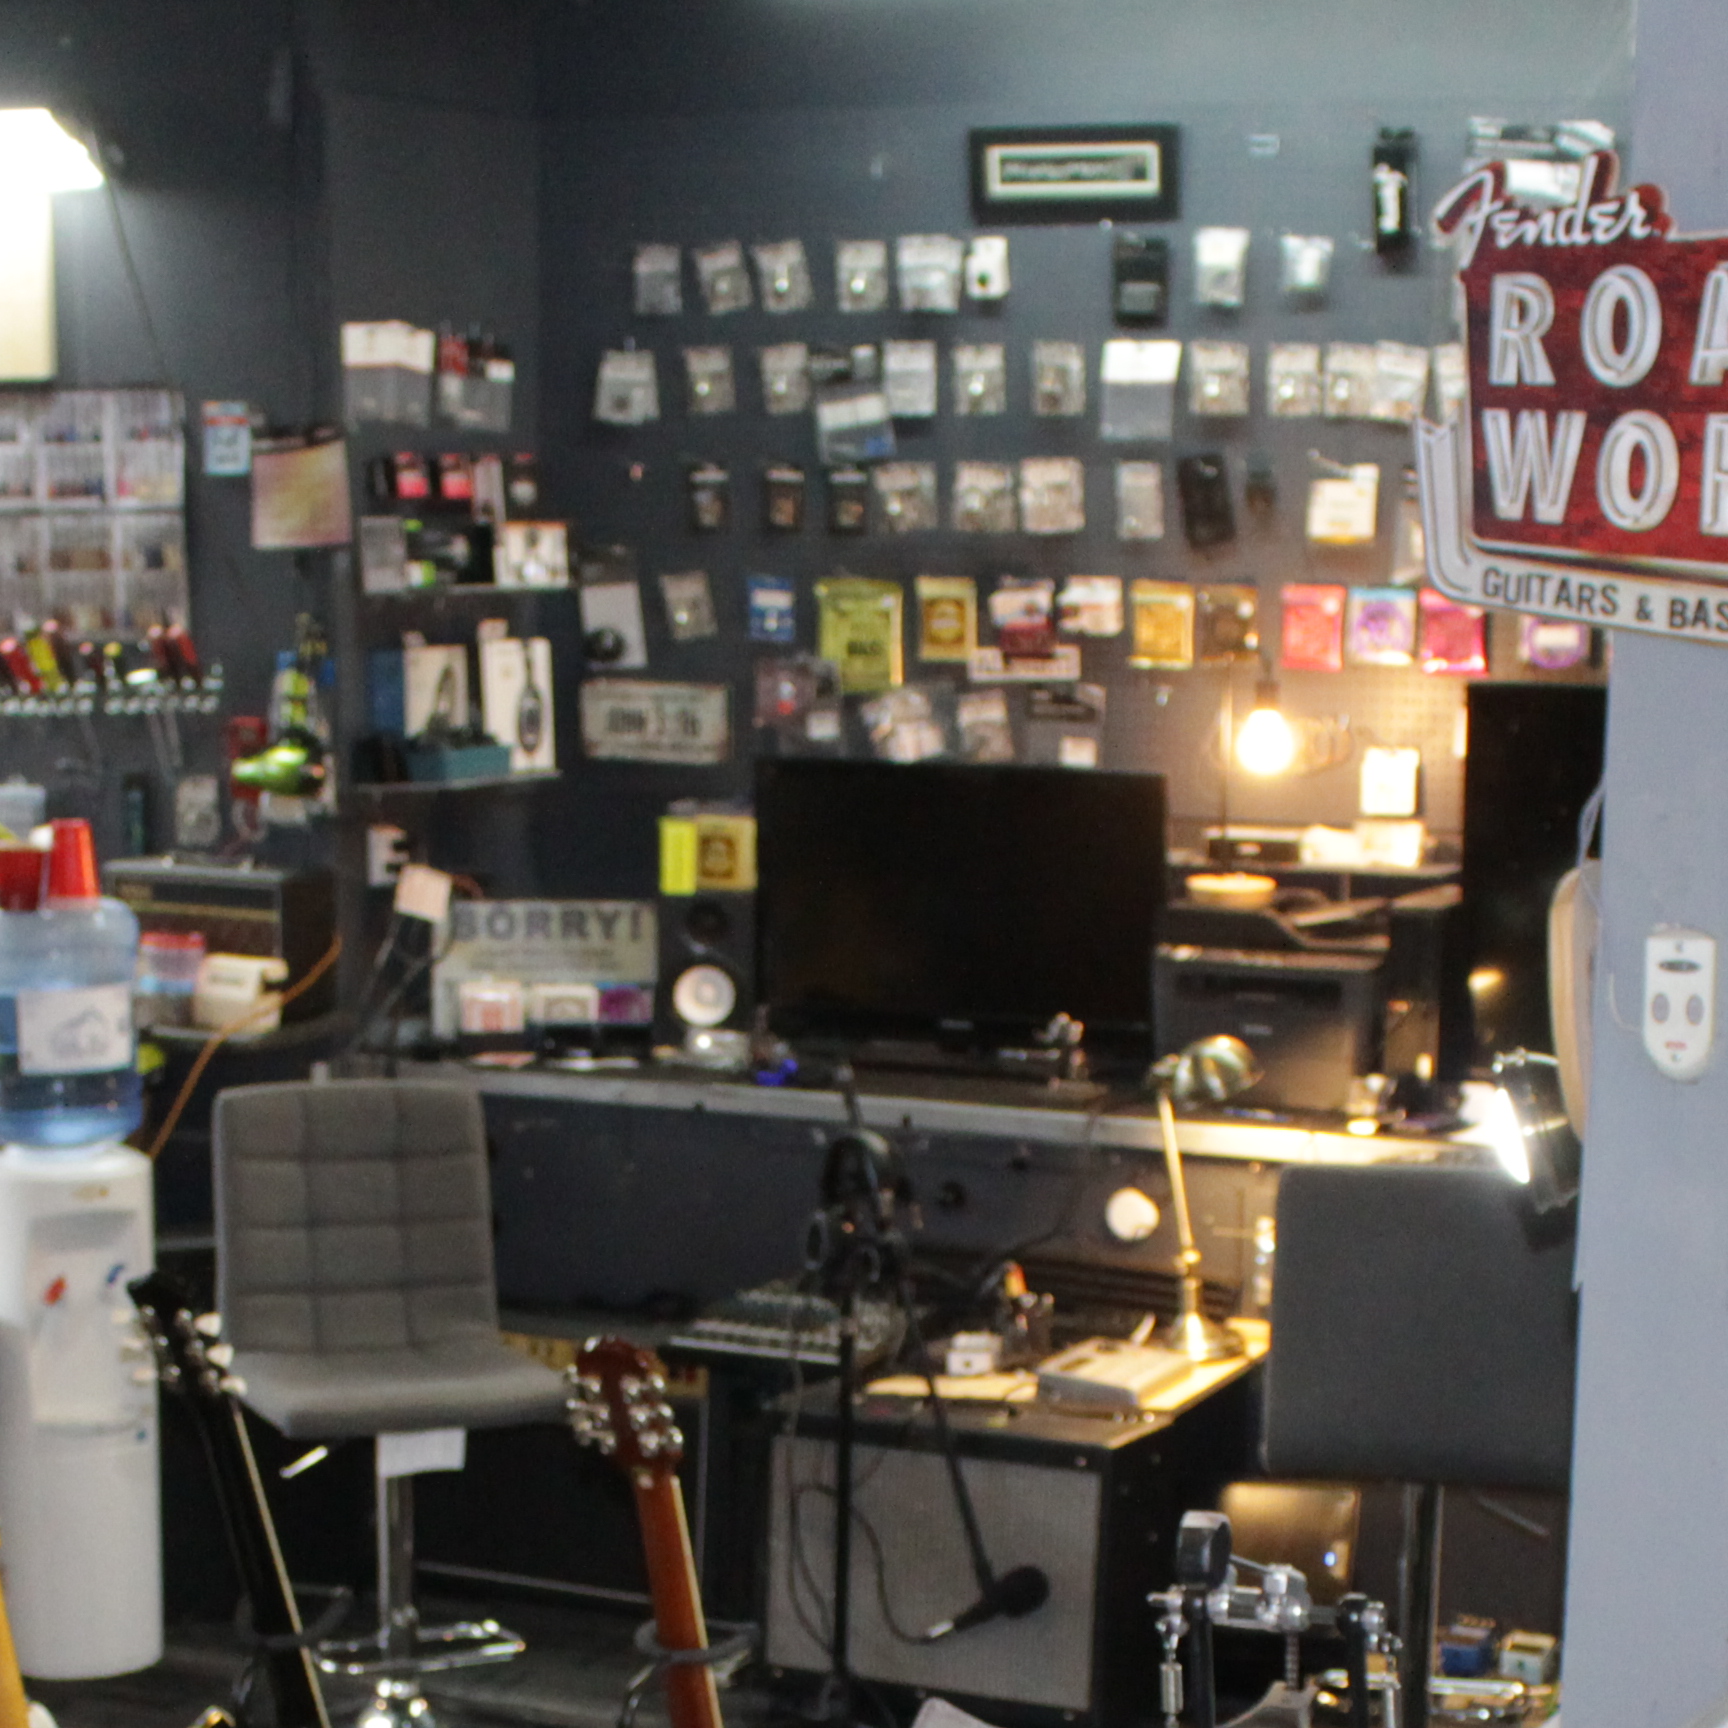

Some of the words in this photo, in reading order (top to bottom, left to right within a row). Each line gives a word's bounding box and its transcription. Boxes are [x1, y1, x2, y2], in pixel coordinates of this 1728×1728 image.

[1434, 152, 1658, 269] Fender
[1481, 566, 1619, 616] GUITARS
[1635, 596, 1656, 622] &
[450, 902, 646, 943] SORRY!
